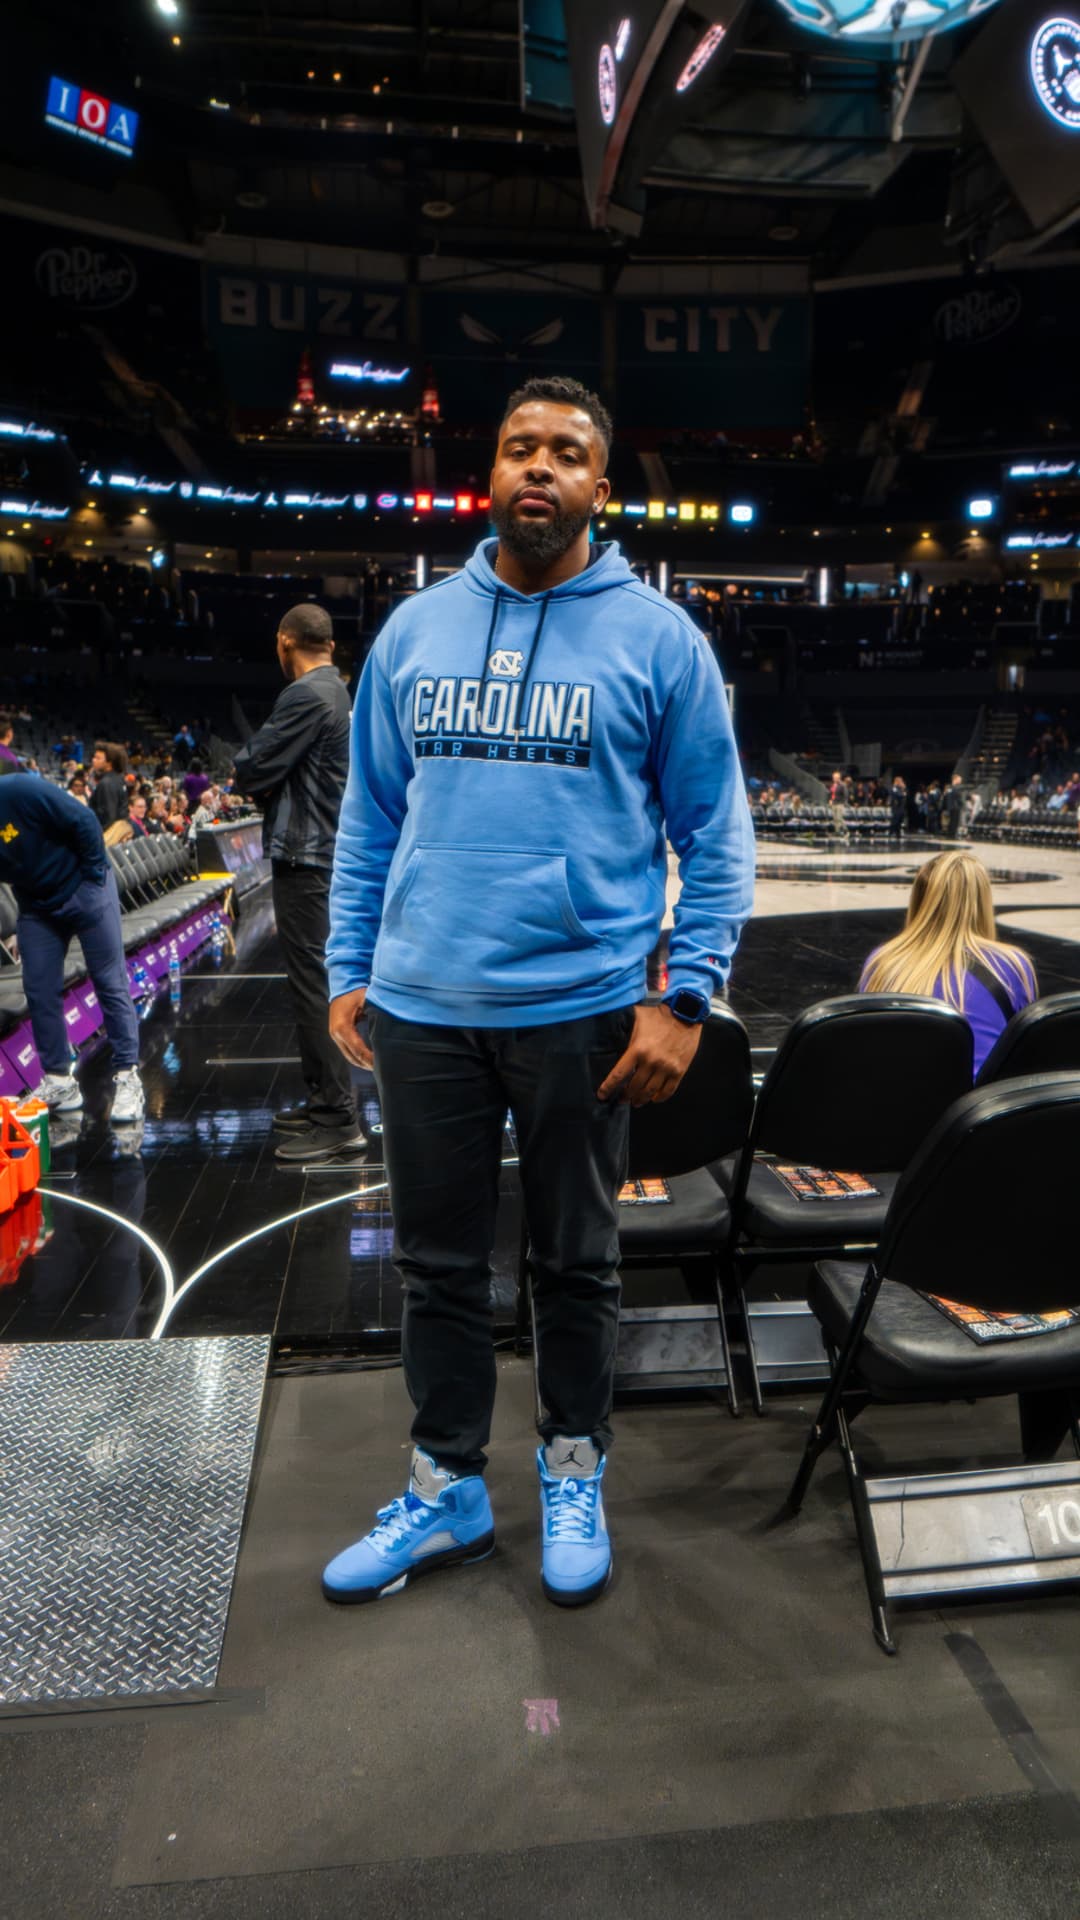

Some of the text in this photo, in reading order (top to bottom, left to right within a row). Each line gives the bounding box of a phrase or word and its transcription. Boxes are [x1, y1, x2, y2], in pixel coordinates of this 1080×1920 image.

[58, 86, 130, 142] IOA
[218, 277, 401, 341] BUZZ
[642, 307, 784, 352] CITY
[413, 677, 594, 745] CAROLINA
[420, 741, 578, 764] TAR HEELS
